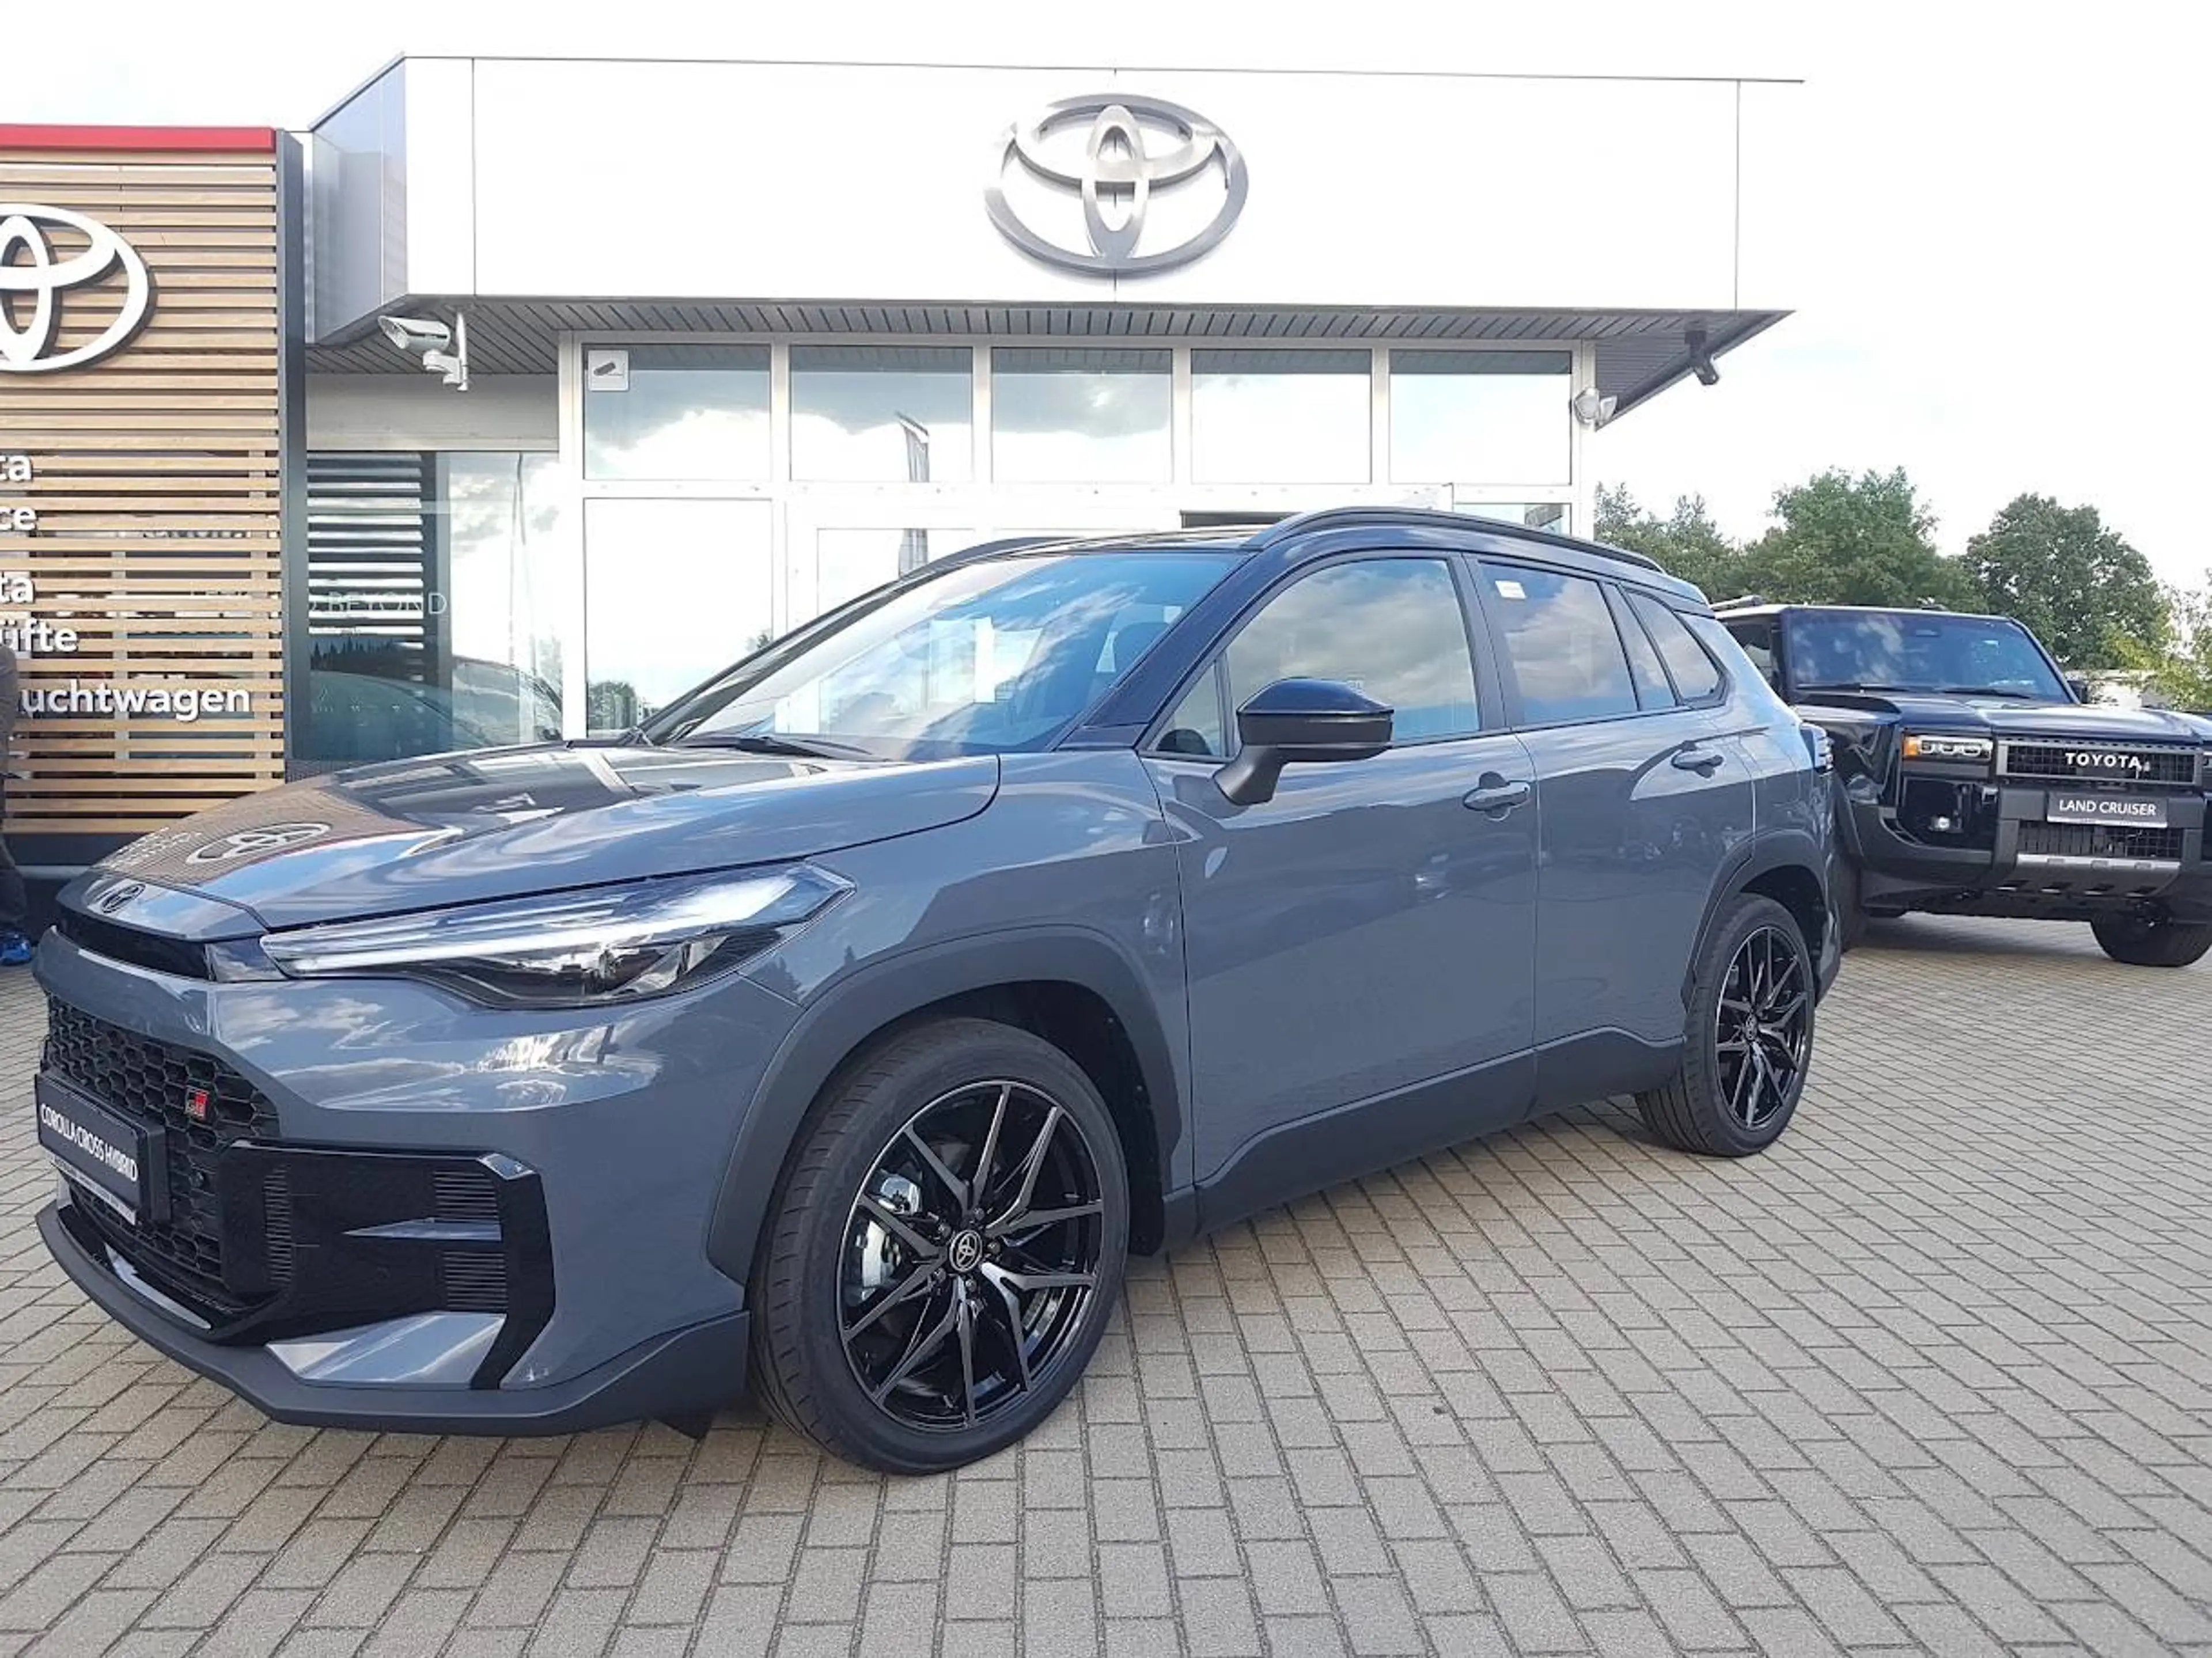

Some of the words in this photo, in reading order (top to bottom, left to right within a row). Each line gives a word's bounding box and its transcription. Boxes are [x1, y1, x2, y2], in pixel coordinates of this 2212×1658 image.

[21, 680, 251, 721] uchtwagen
[2065, 752, 2142, 769] TOYOTA
[2059, 799, 2097, 813] LAND
[2099, 801, 2157, 816] CRUISER
[40, 1103, 77, 1144] COROLLA
[76, 1126, 105, 1162] CROSS
[105, 1143, 139, 1182] HYBRID
